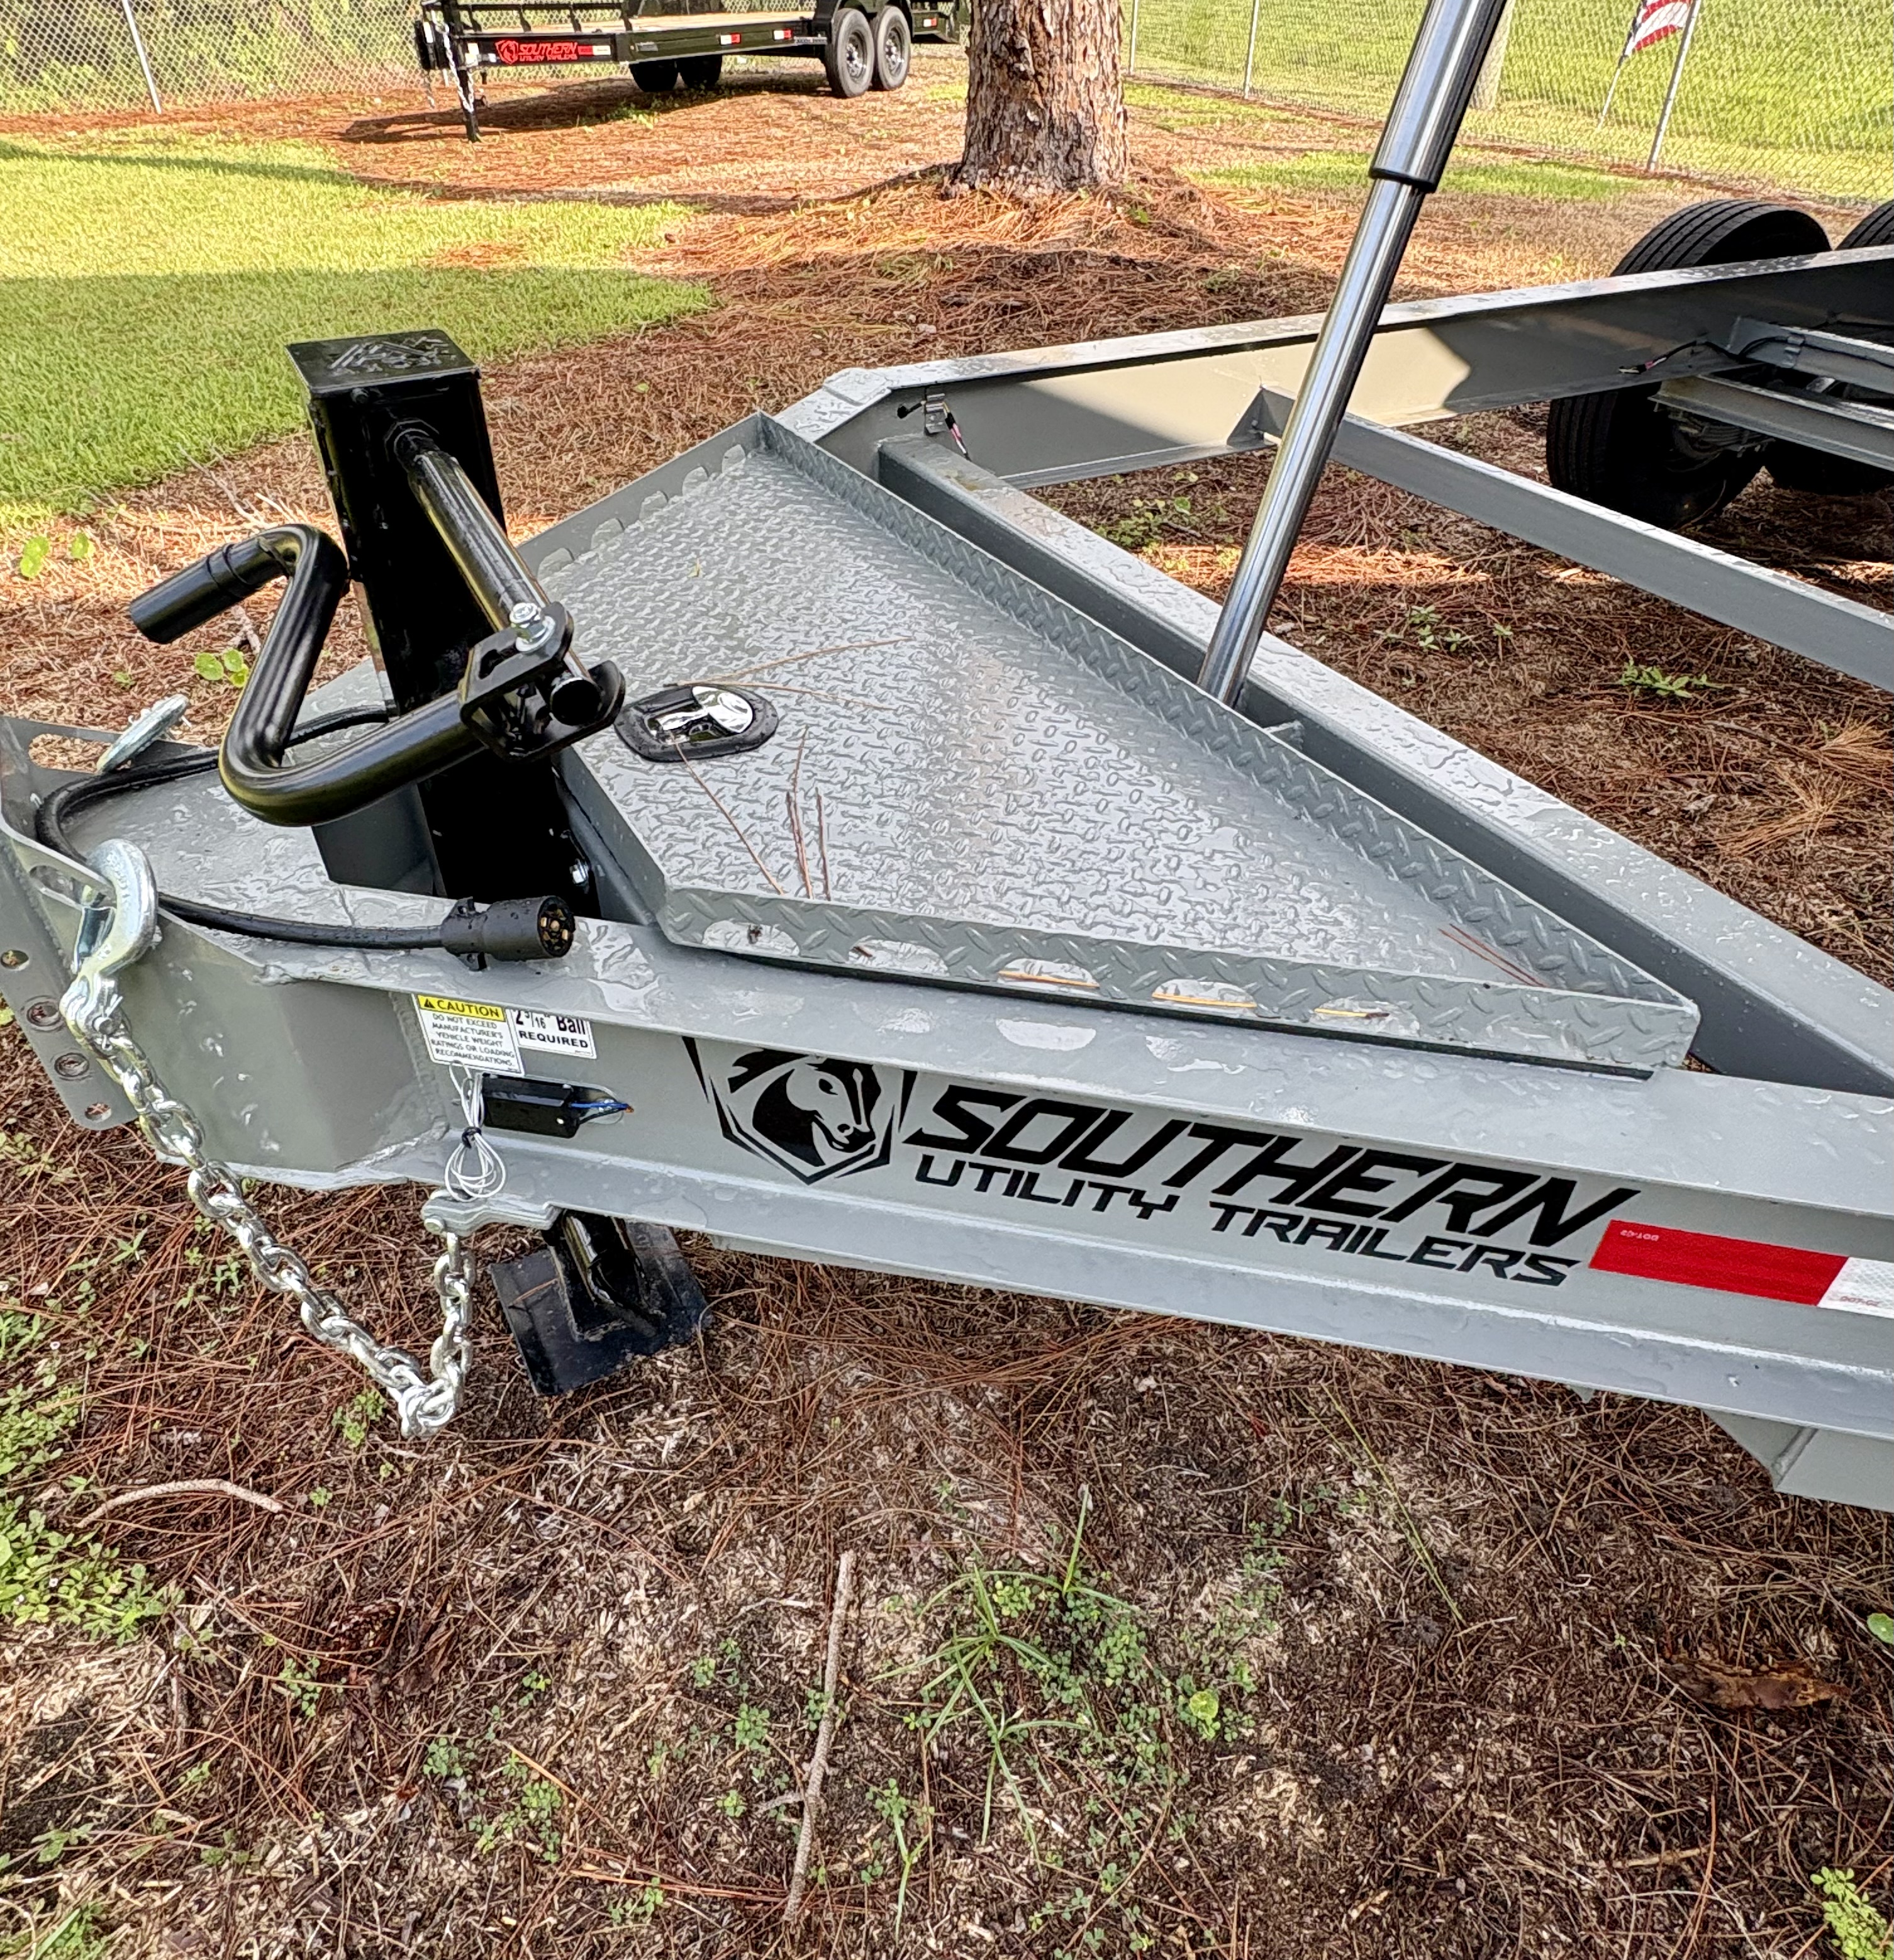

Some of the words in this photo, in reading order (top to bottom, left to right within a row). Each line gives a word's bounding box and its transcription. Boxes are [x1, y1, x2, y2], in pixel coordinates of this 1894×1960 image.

[519, 42, 578, 55] SOUTHERN
[437, 1000, 499, 1018] CAUTION
[433, 1013, 445, 1022] DO
[447, 1016, 464, 1025] NOT
[466, 1018, 498, 1029] EXCEED
[556, 1015, 586, 1035] Ball
[437, 1032, 470, 1042] VEHICLE
[472, 1036, 503, 1047] WEIGHT
[518, 1030, 588, 1048] REQUIRED
[431, 1039, 464, 1050] RATINGS
[479, 1047, 515, 1058] LOADING
[904, 1085, 1641, 1248] SOUTHERN
[915, 1155, 1180, 1219] UTILITY
[1210, 1201, 1582, 1287] TRAILERS
